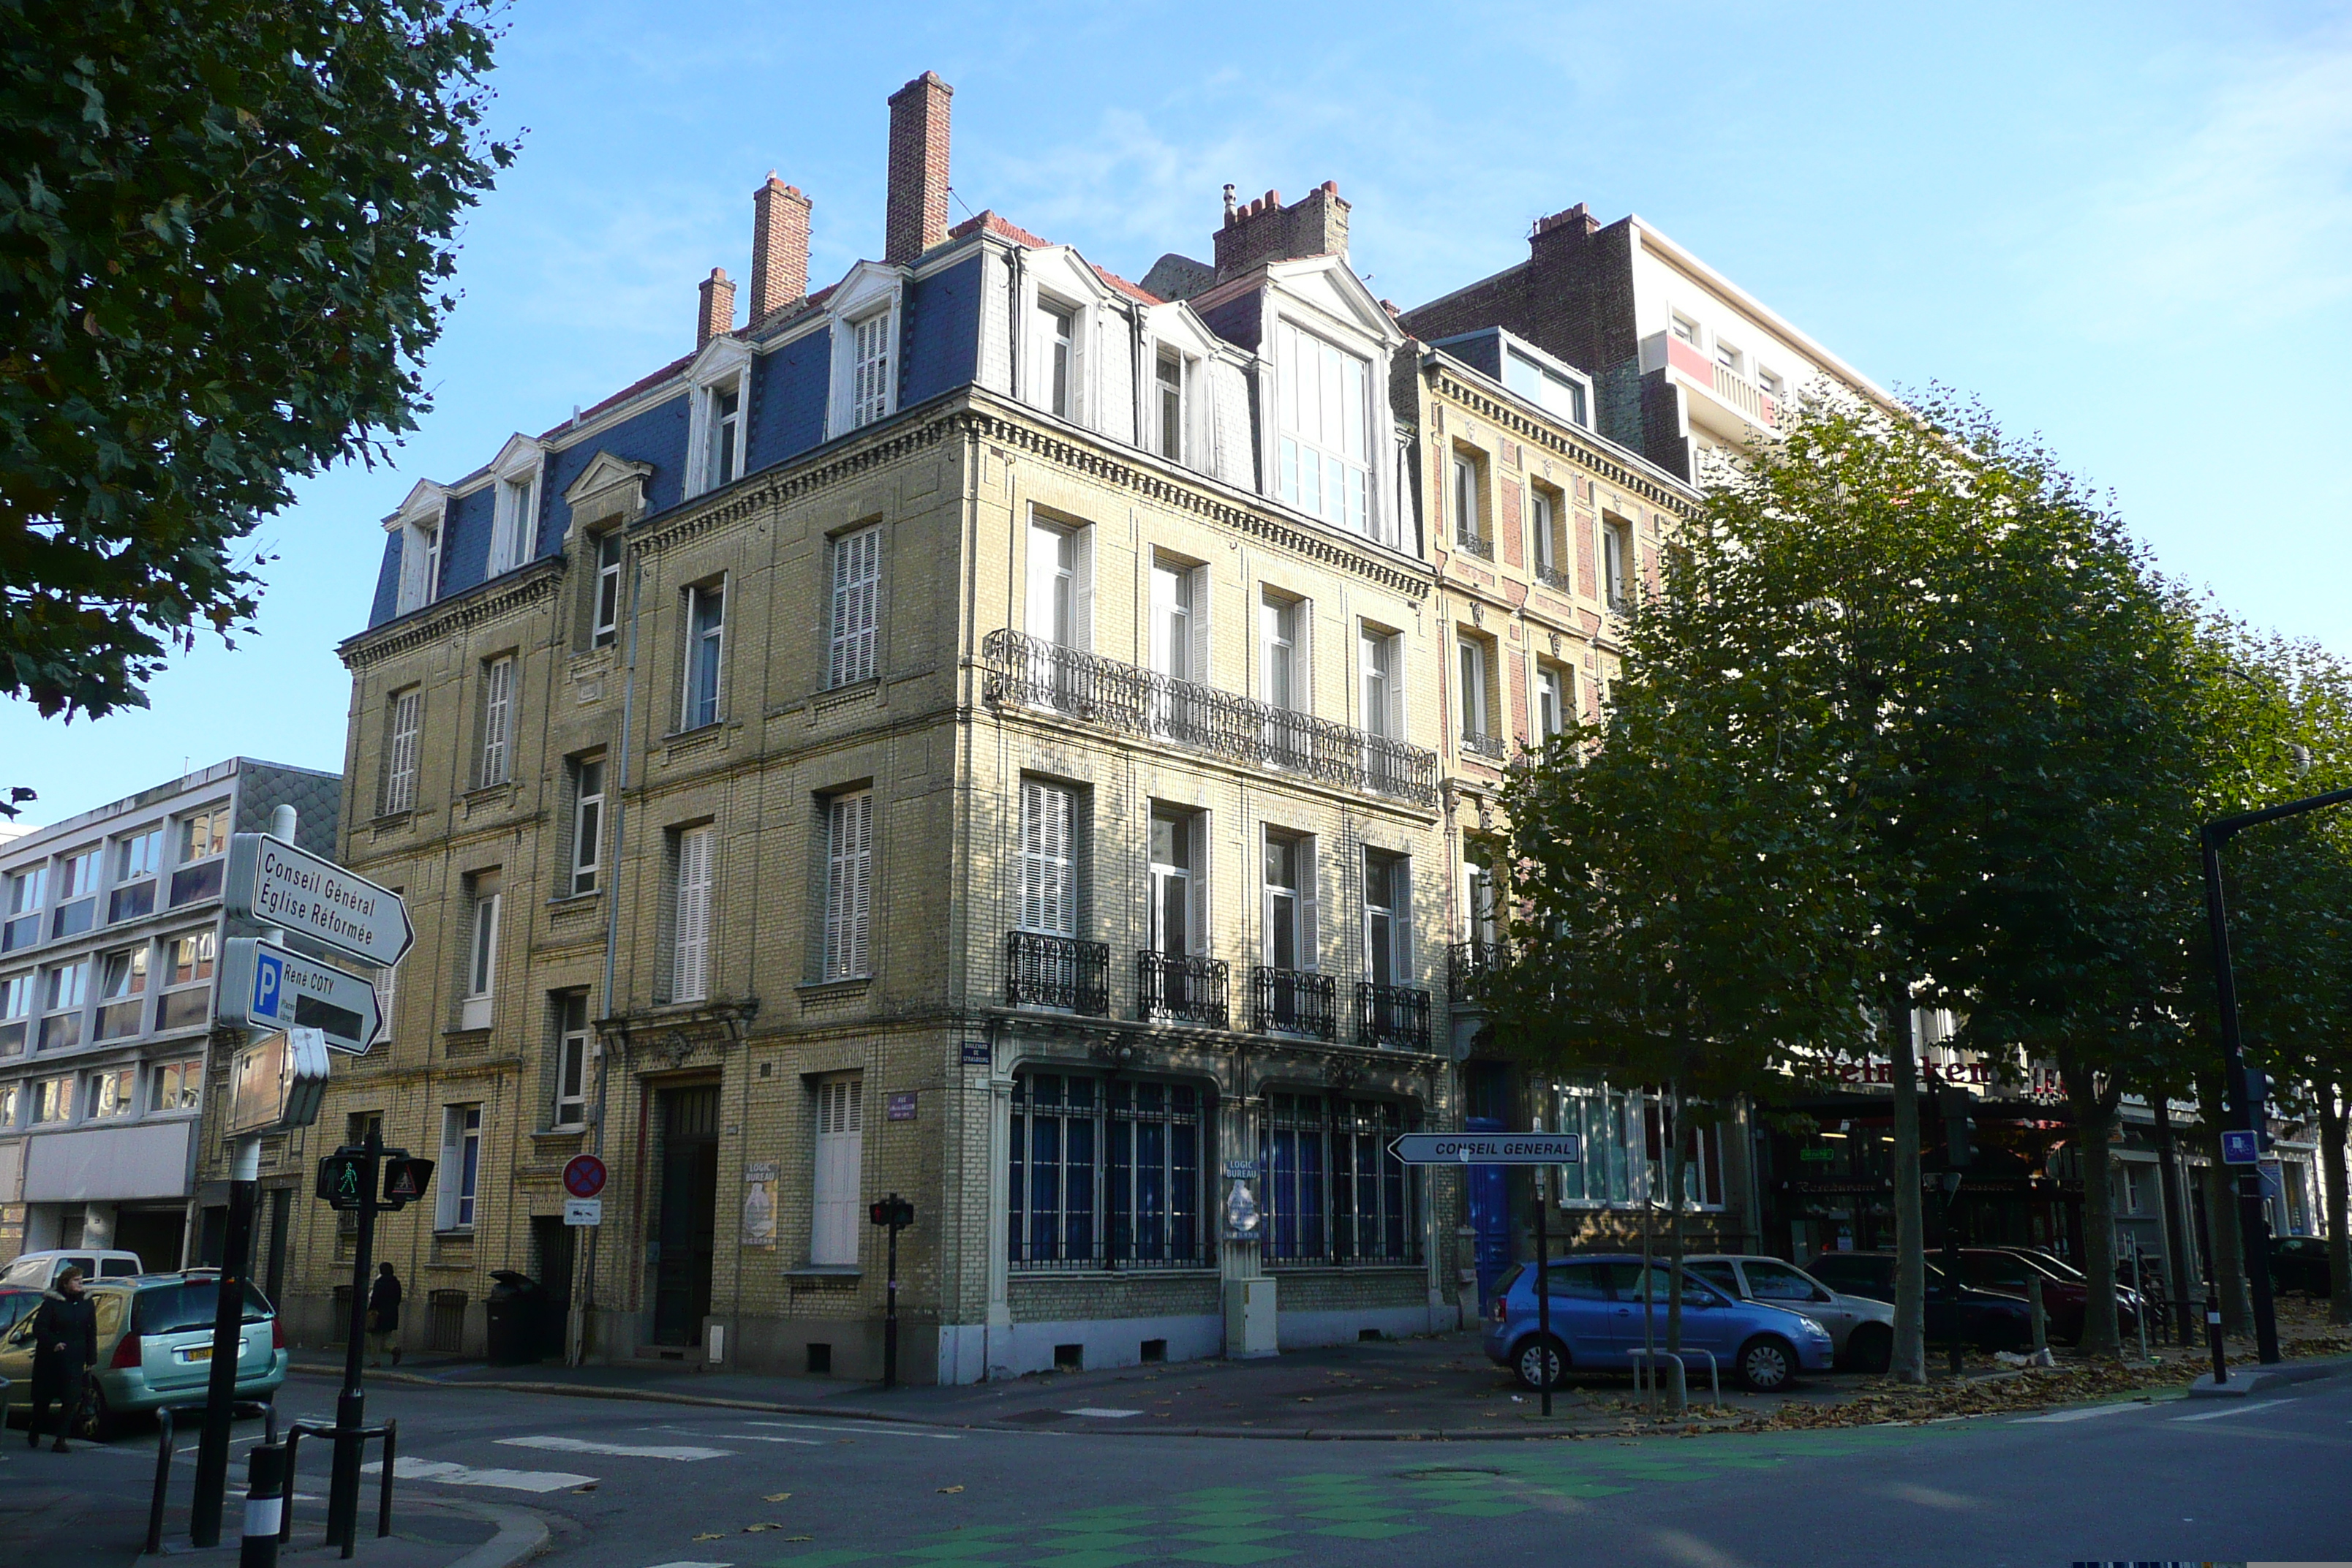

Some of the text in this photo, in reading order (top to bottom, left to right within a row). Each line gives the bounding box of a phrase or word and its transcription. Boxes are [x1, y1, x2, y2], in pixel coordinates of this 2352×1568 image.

[265, 853, 375, 917] Conseil Général
[260, 878, 372, 945] Église Réformée
[259, 962, 276, 1006] P
[284, 963, 335, 995] René COTY
[1436, 1142, 1571, 1155] CONSEIL GENERAL
[750, 1163, 771, 1172] LOGIC
[1230, 1160, 1252, 1169] LOGIC
[746, 1172, 774, 1182] BUREAU
[1226, 1169, 1256, 1178] BUREAU
